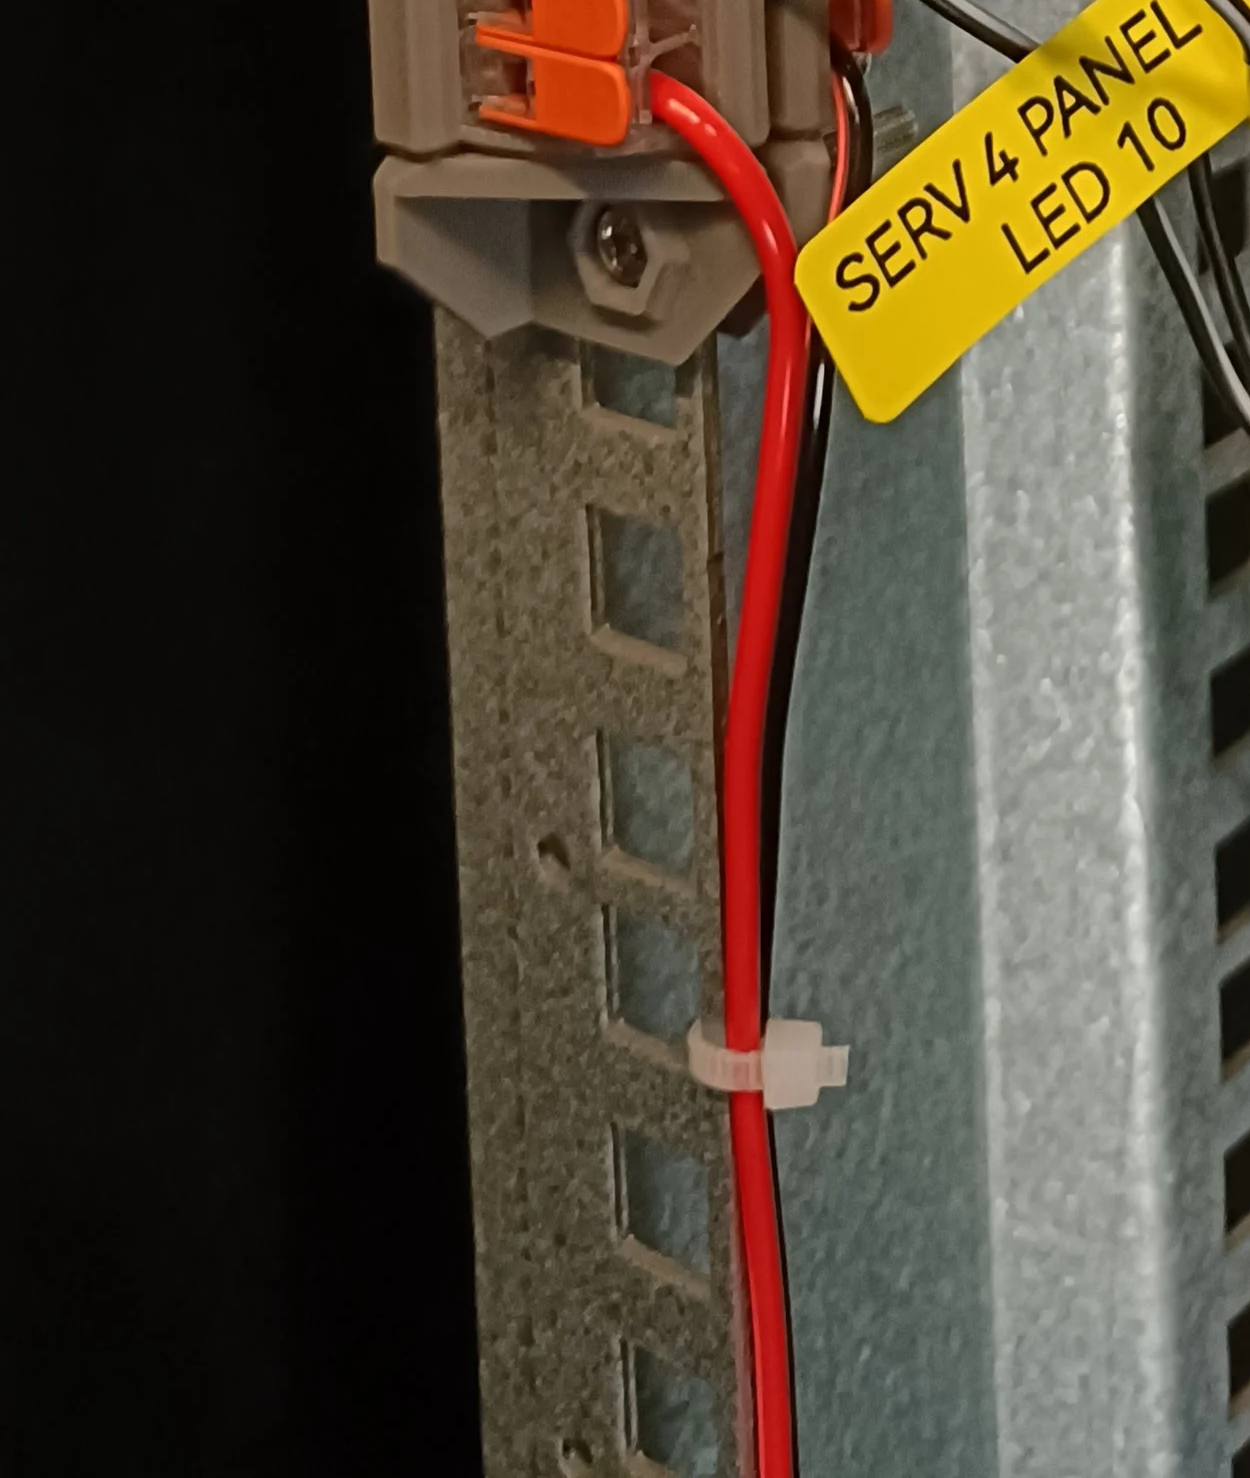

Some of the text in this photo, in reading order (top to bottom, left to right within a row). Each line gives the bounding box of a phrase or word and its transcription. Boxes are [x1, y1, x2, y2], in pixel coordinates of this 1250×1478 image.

[834, 157, 971, 313] SERV
[985, 130, 1020, 187] 4
[1000, 97, 1187, 275] LED 10
